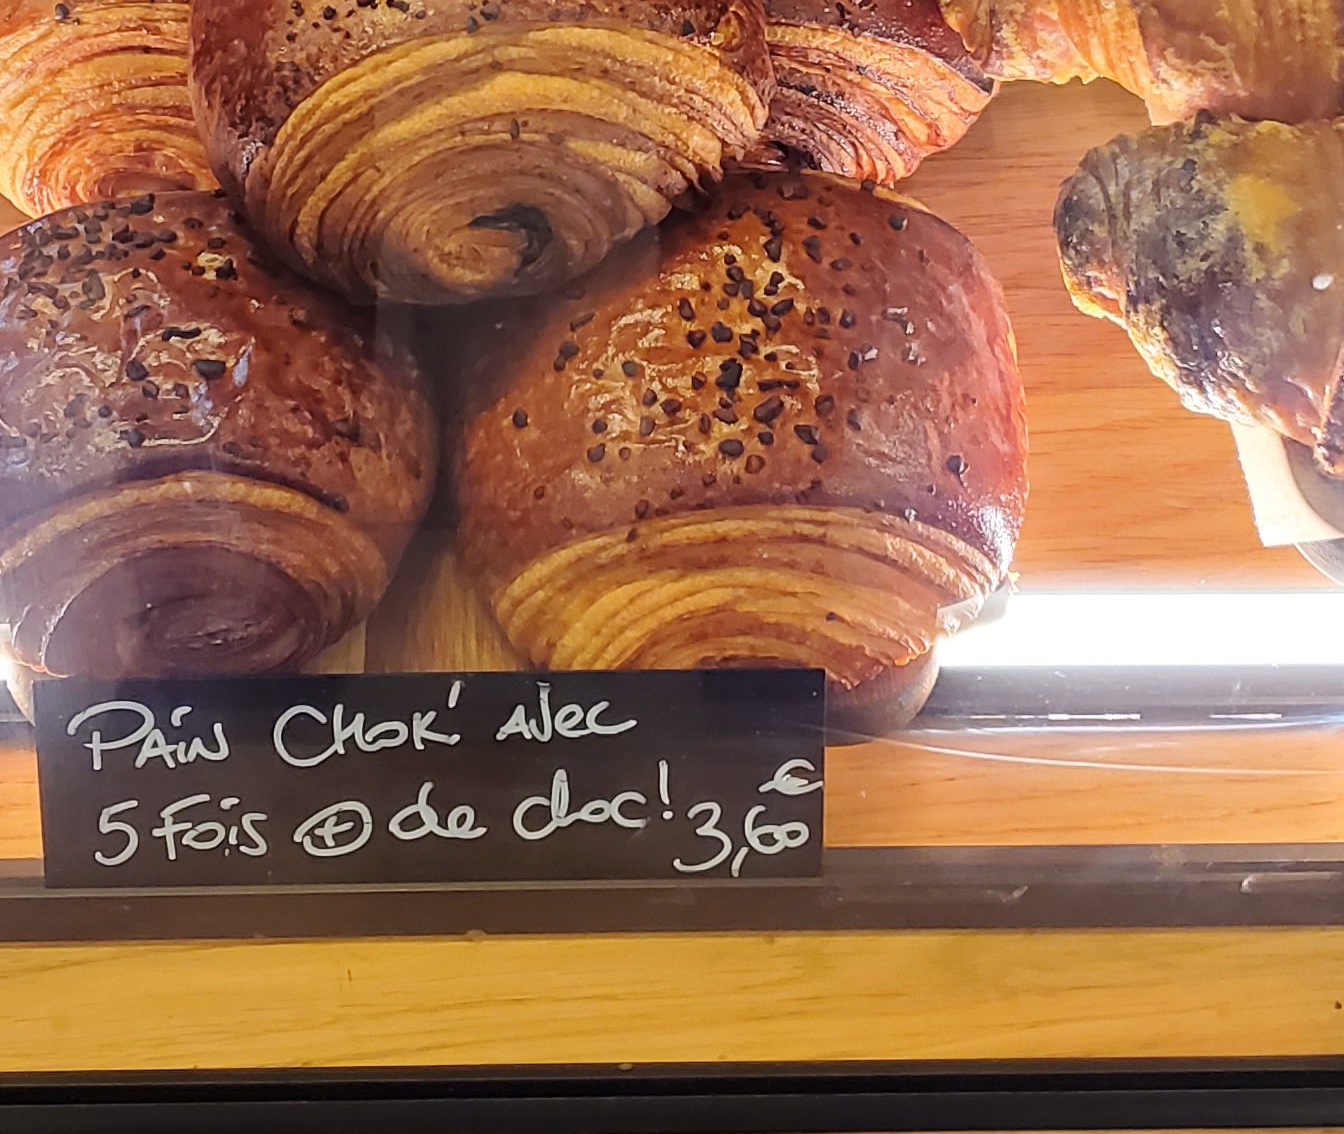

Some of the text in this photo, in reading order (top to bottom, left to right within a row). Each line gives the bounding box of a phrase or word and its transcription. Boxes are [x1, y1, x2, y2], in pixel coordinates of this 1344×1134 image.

[93, 799, 140, 867] 5
[387, 780, 489, 841] de
[672, 800, 811, 878] 3,60
